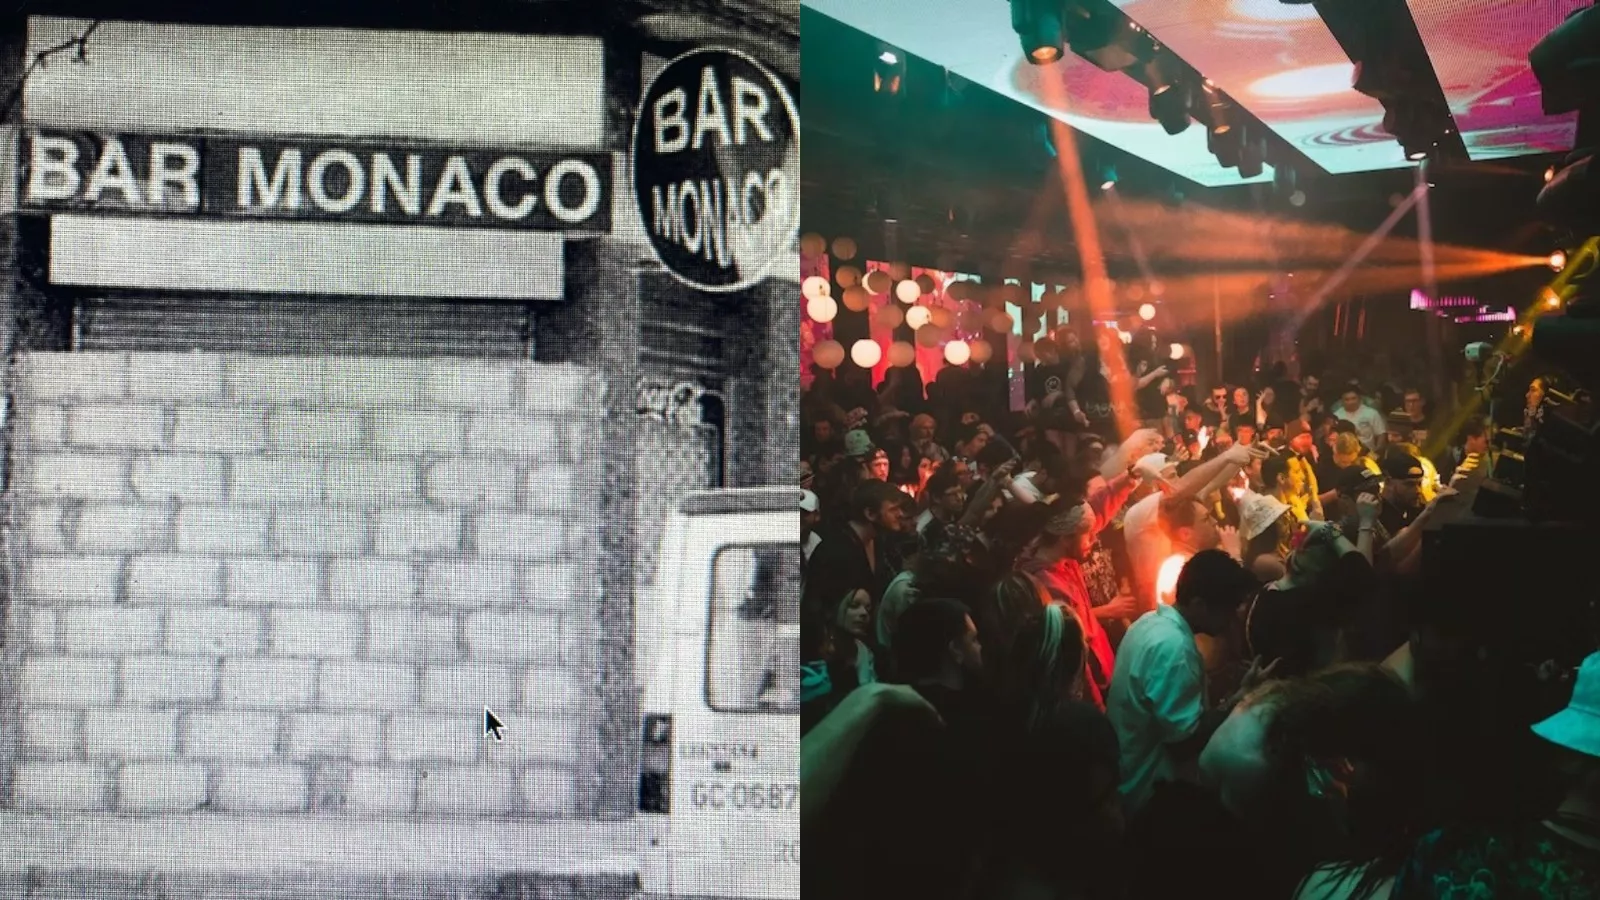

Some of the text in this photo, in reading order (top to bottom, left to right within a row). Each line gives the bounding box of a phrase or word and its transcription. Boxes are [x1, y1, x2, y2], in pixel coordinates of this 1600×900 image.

[653, 65, 774, 153] BAR
[26, 132, 601, 223] BAR MONACO
[652, 168, 788, 269] MONACO
